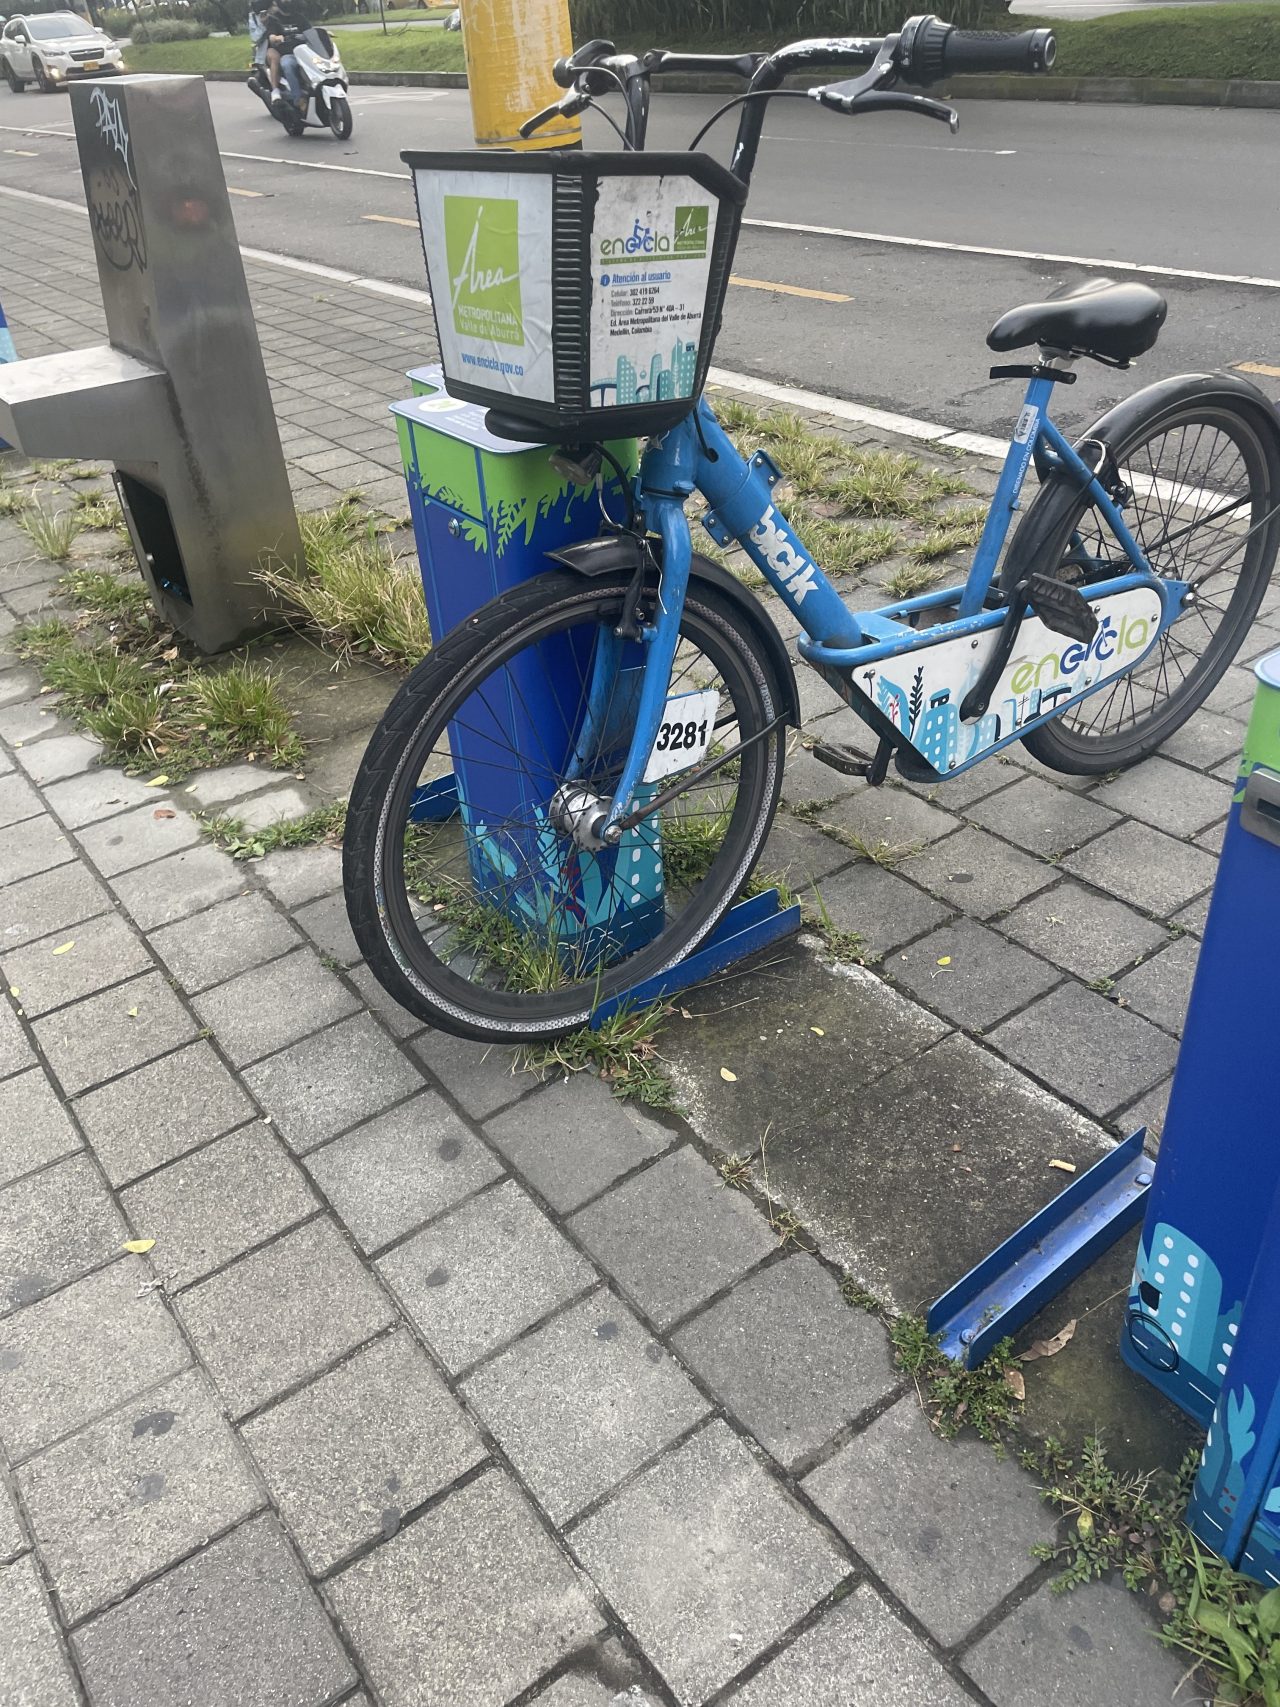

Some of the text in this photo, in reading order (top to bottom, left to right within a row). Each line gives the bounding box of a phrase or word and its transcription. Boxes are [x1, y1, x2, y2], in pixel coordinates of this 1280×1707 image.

[612, 271, 671, 283] Atención al usuario
[458, 304, 518, 326] METROPOLITANA
[630, 315, 660, 325] Metropolitana
[669, 313, 680, 321] Valle
[460, 318, 478, 333] Valle
[631, 327, 652, 335] Colombia
[461, 352, 524, 376] www.encicla.gov.co
[1022, 451, 1030, 461] EN
[1026, 418, 1040, 451] COLOMBIA
[656, 720, 708, 751] 3281
